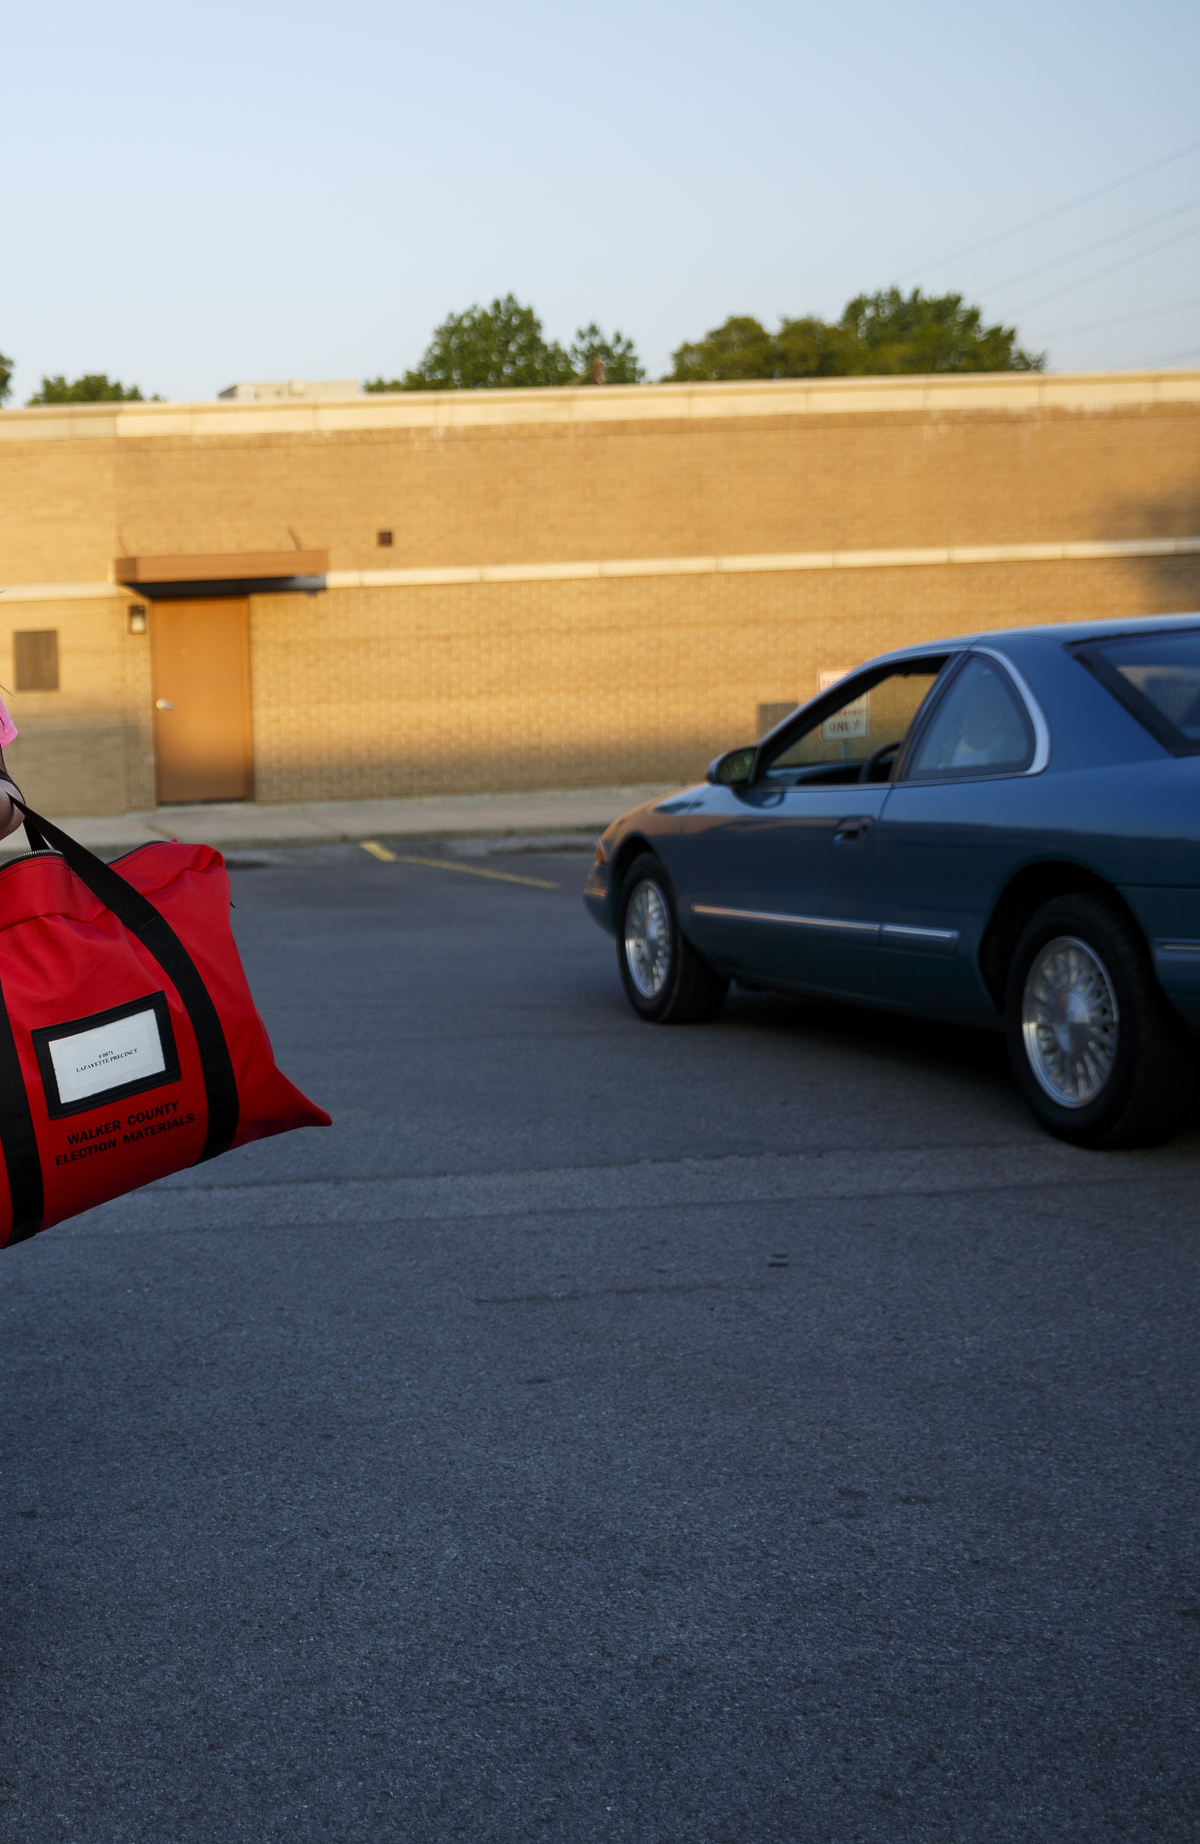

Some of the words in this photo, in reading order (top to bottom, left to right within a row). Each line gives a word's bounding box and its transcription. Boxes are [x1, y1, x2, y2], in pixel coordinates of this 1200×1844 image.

[76, 1059, 109, 1072] LAFAYETTE
[110, 1048, 137, 1061] PRECINCT
[55, 1138, 117, 1166] ELECTION
[123, 1113, 195, 1144] MATERIALS
[66, 1120, 121, 1145] WALKER
[127, 1100, 178, 1126] COUNTY
